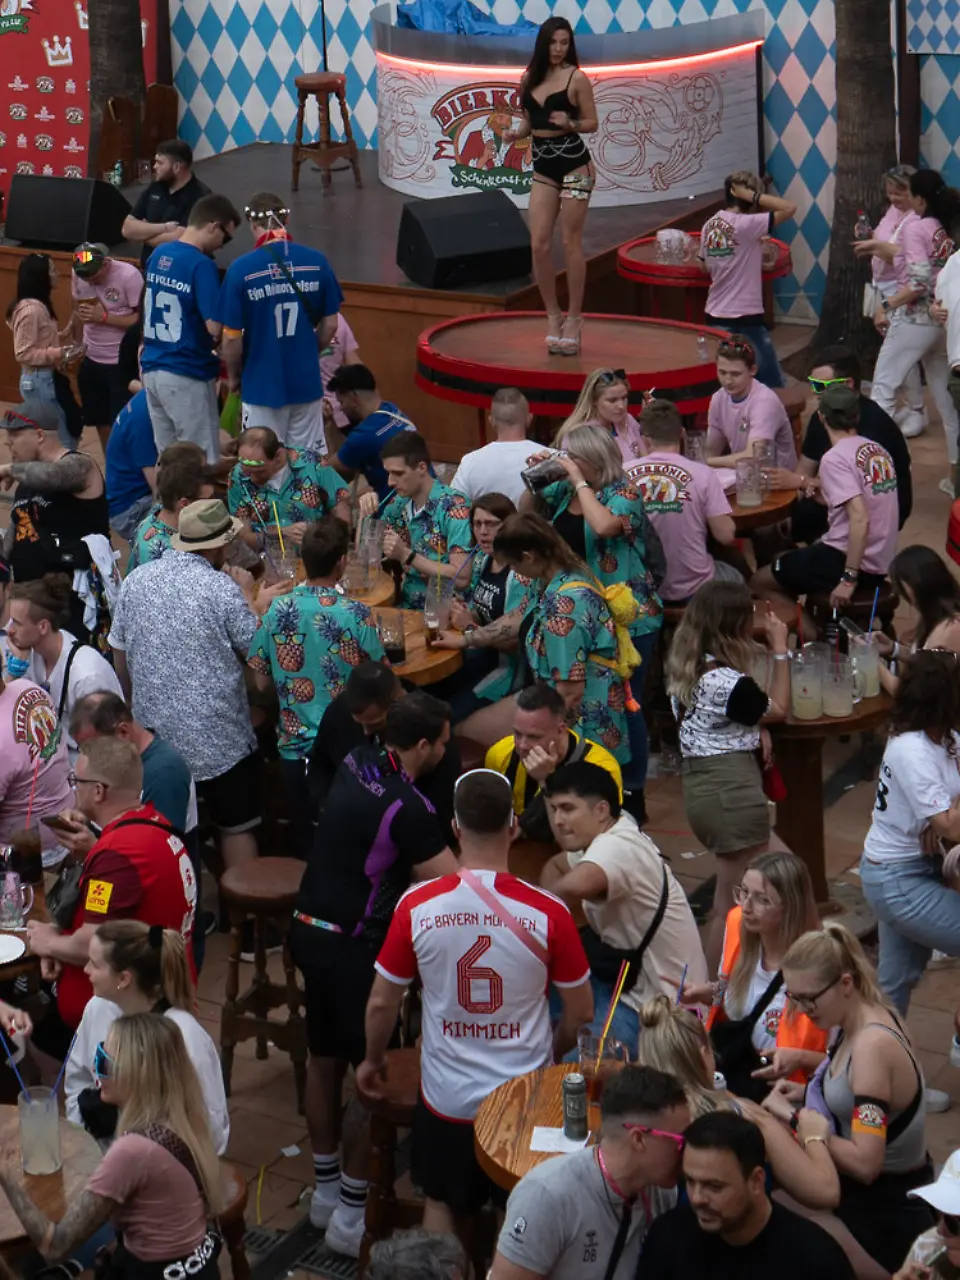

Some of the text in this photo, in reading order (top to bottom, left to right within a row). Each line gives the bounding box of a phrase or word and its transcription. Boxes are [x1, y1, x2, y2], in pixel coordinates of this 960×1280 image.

[144, 287, 182, 343] 13
[273, 301, 298, 339] 17
[420, 917, 433, 930] FC
[434, 912, 480, 929] BAYERN
[457, 935, 504, 1015] 6
[442, 1019, 521, 1040] KIMMICH
